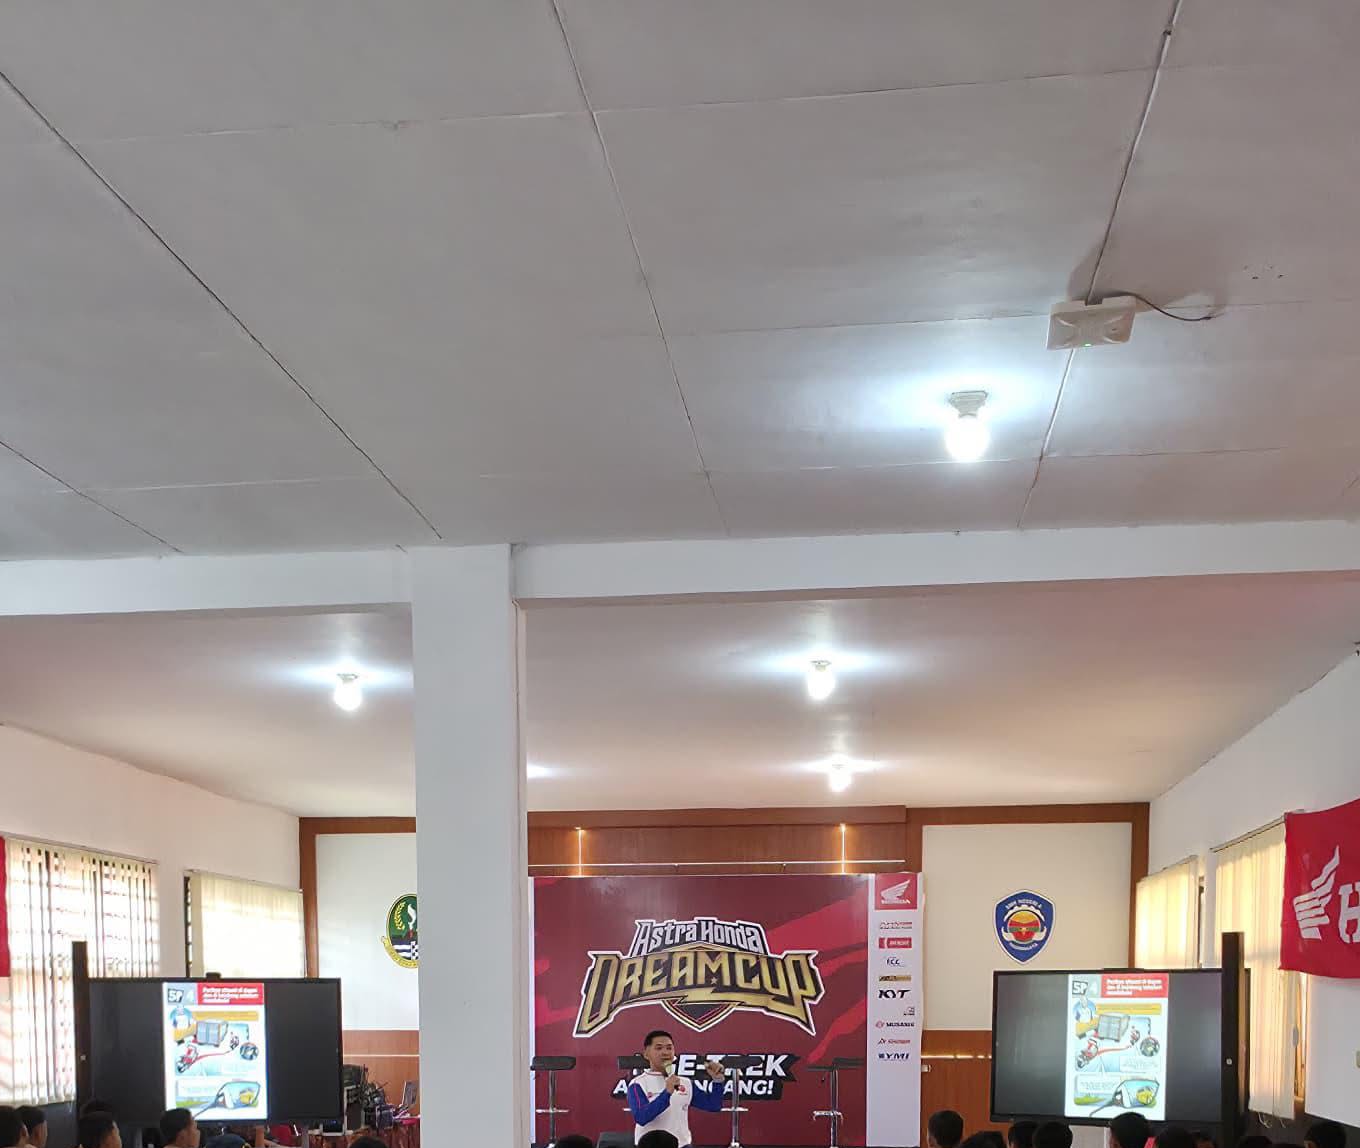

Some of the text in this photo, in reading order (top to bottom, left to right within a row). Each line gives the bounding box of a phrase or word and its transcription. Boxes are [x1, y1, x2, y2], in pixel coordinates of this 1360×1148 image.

[632, 919, 763, 955] Astra Honda
[878, 990, 911, 998] KYT
